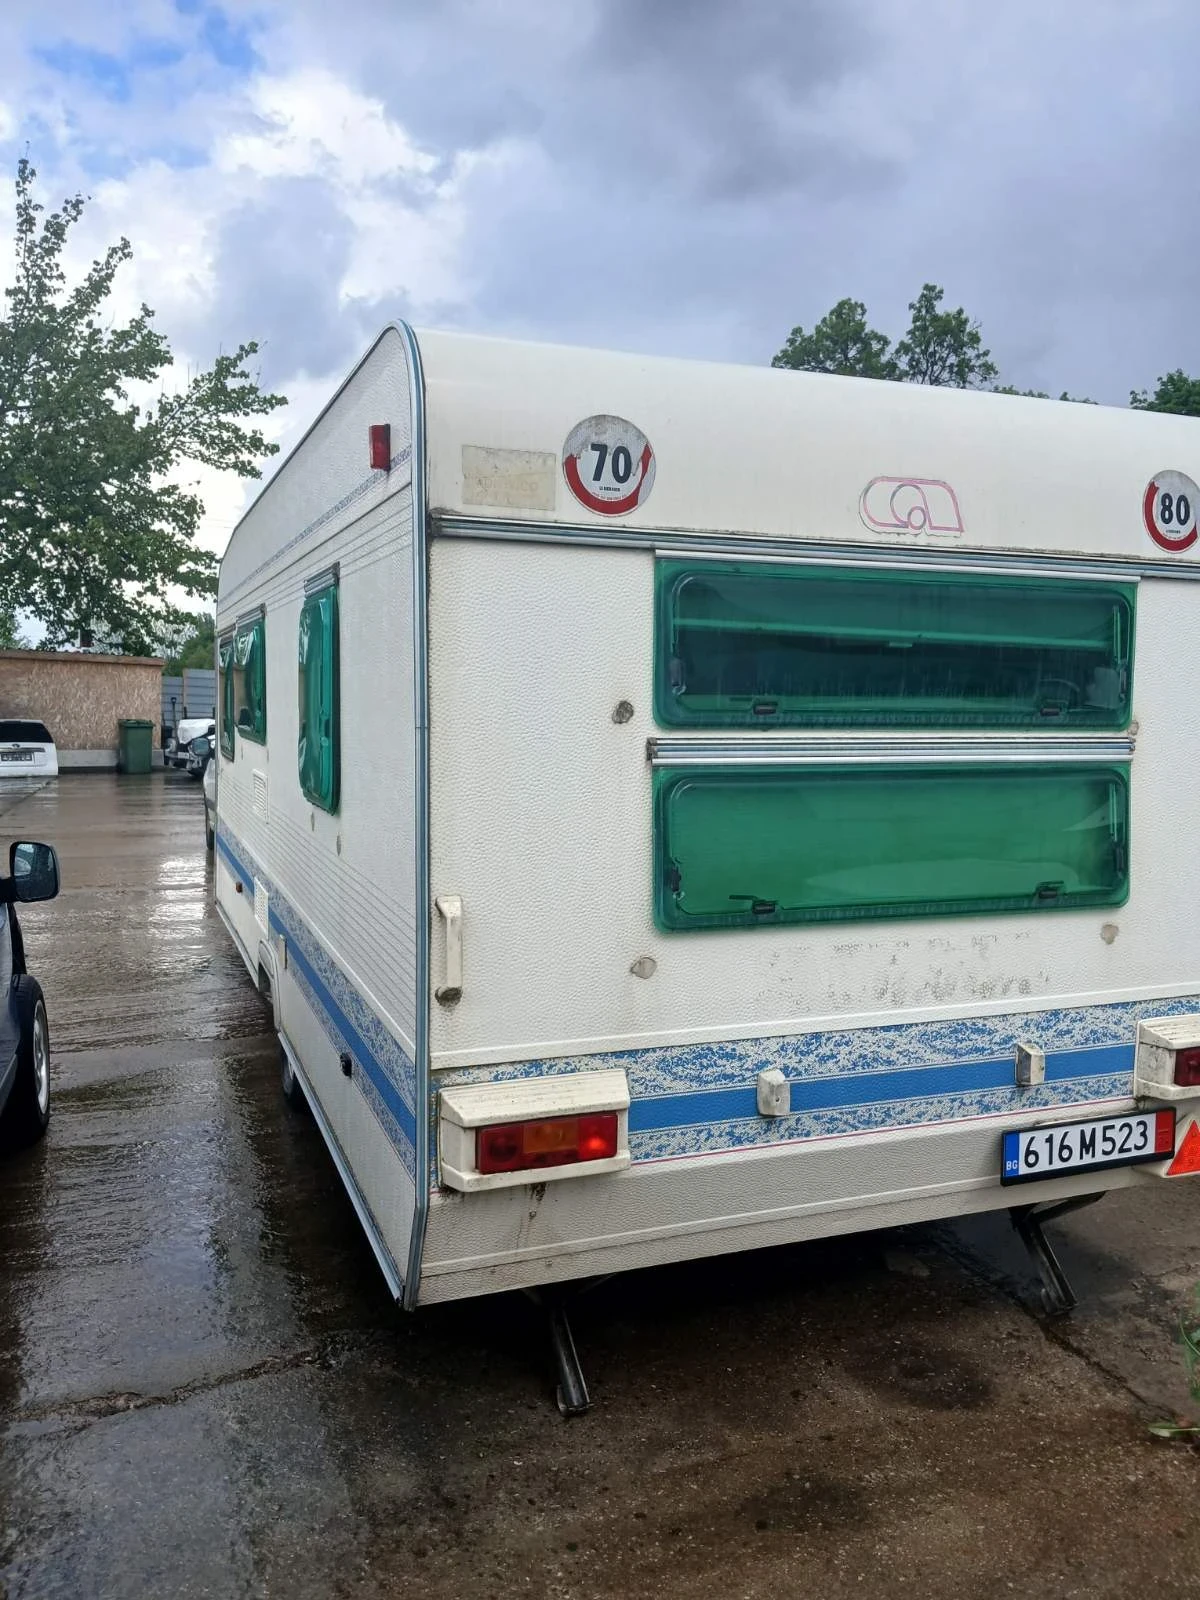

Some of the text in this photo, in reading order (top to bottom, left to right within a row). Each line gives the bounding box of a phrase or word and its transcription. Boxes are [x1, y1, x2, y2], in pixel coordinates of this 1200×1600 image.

[590, 443, 632, 484] 70
[1160, 492, 1190, 526] 80
[1024, 1120, 1148, 1168] 616M523
[1006, 1160, 1018, 1171] BG
